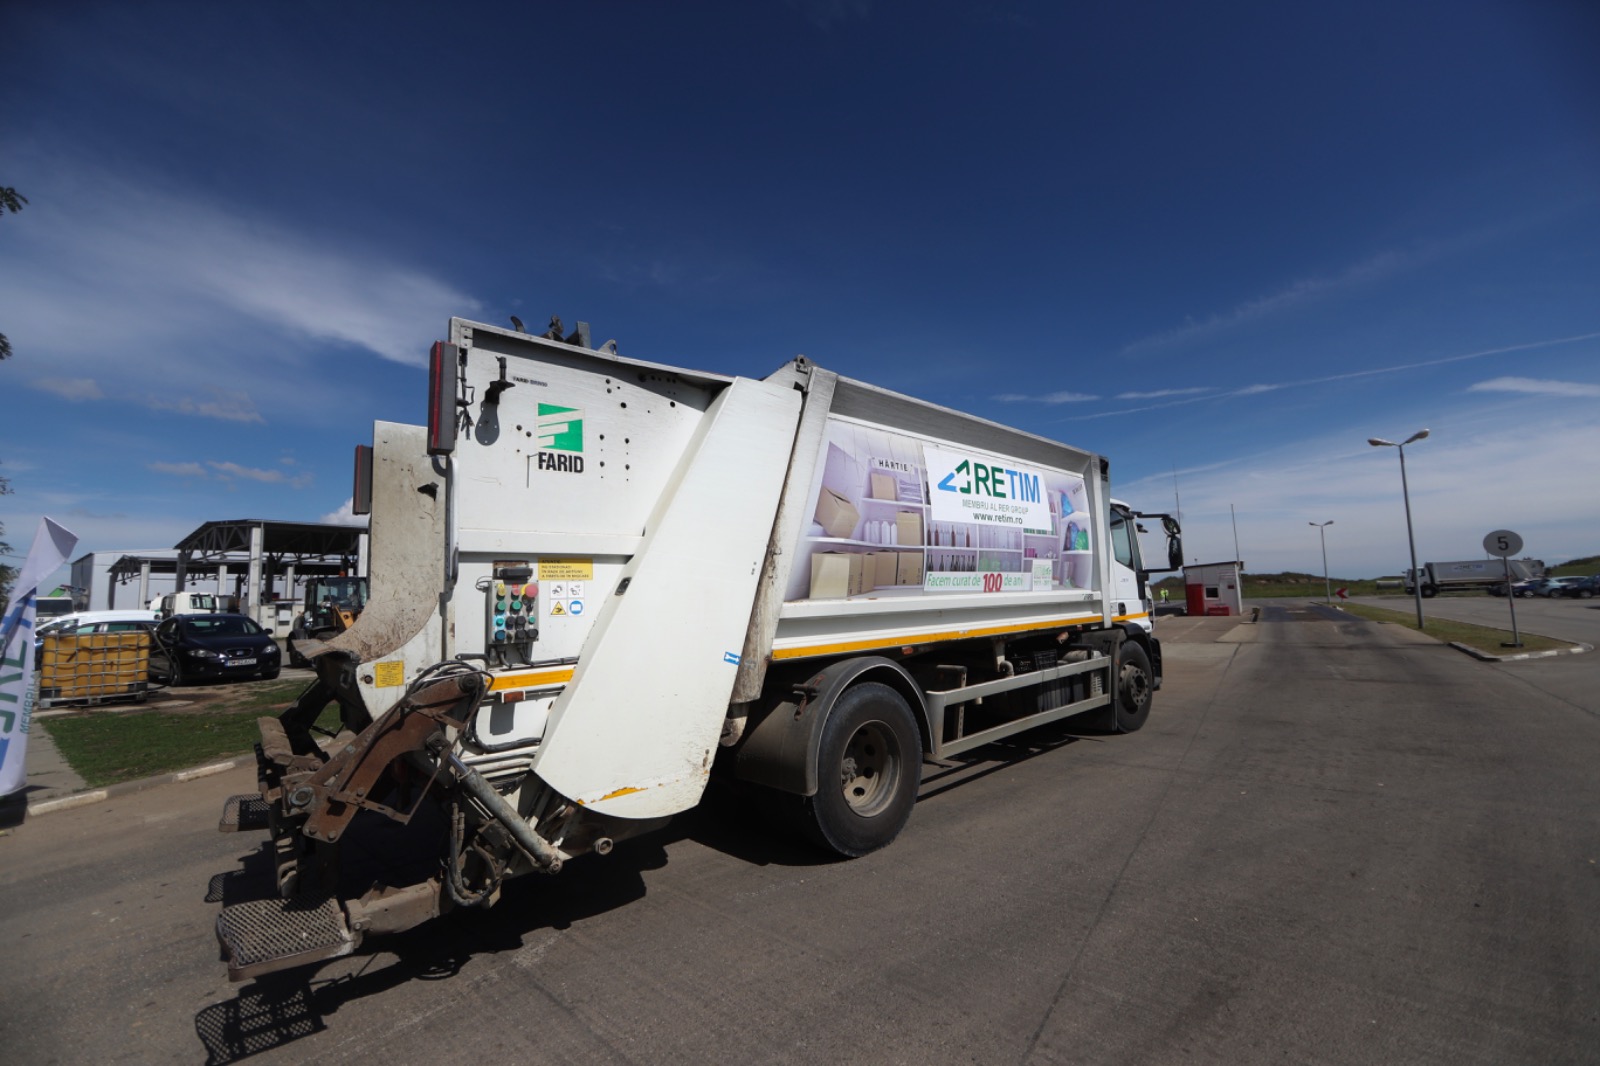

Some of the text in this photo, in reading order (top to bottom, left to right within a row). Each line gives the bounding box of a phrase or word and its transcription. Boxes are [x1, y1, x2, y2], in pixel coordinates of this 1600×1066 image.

[538, 451, 584, 473] FARID
[973, 462, 1041, 503] RETIM
[962, 499, 989, 511] MEMBRU
[990, 502, 998, 512] AL
[1010, 504, 1029, 515] GROUP
[973, 512, 1023, 525] www.retim.ro
[1497, 535, 1509, 551] 5
[927, 573, 951, 586] Facem
[952, 575, 971, 586] curat
[972, 575, 981, 586] de
[983, 573, 1003, 593] 100
[1004, 574, 1013, 586] de
[1013, 574, 1023, 586] ani
